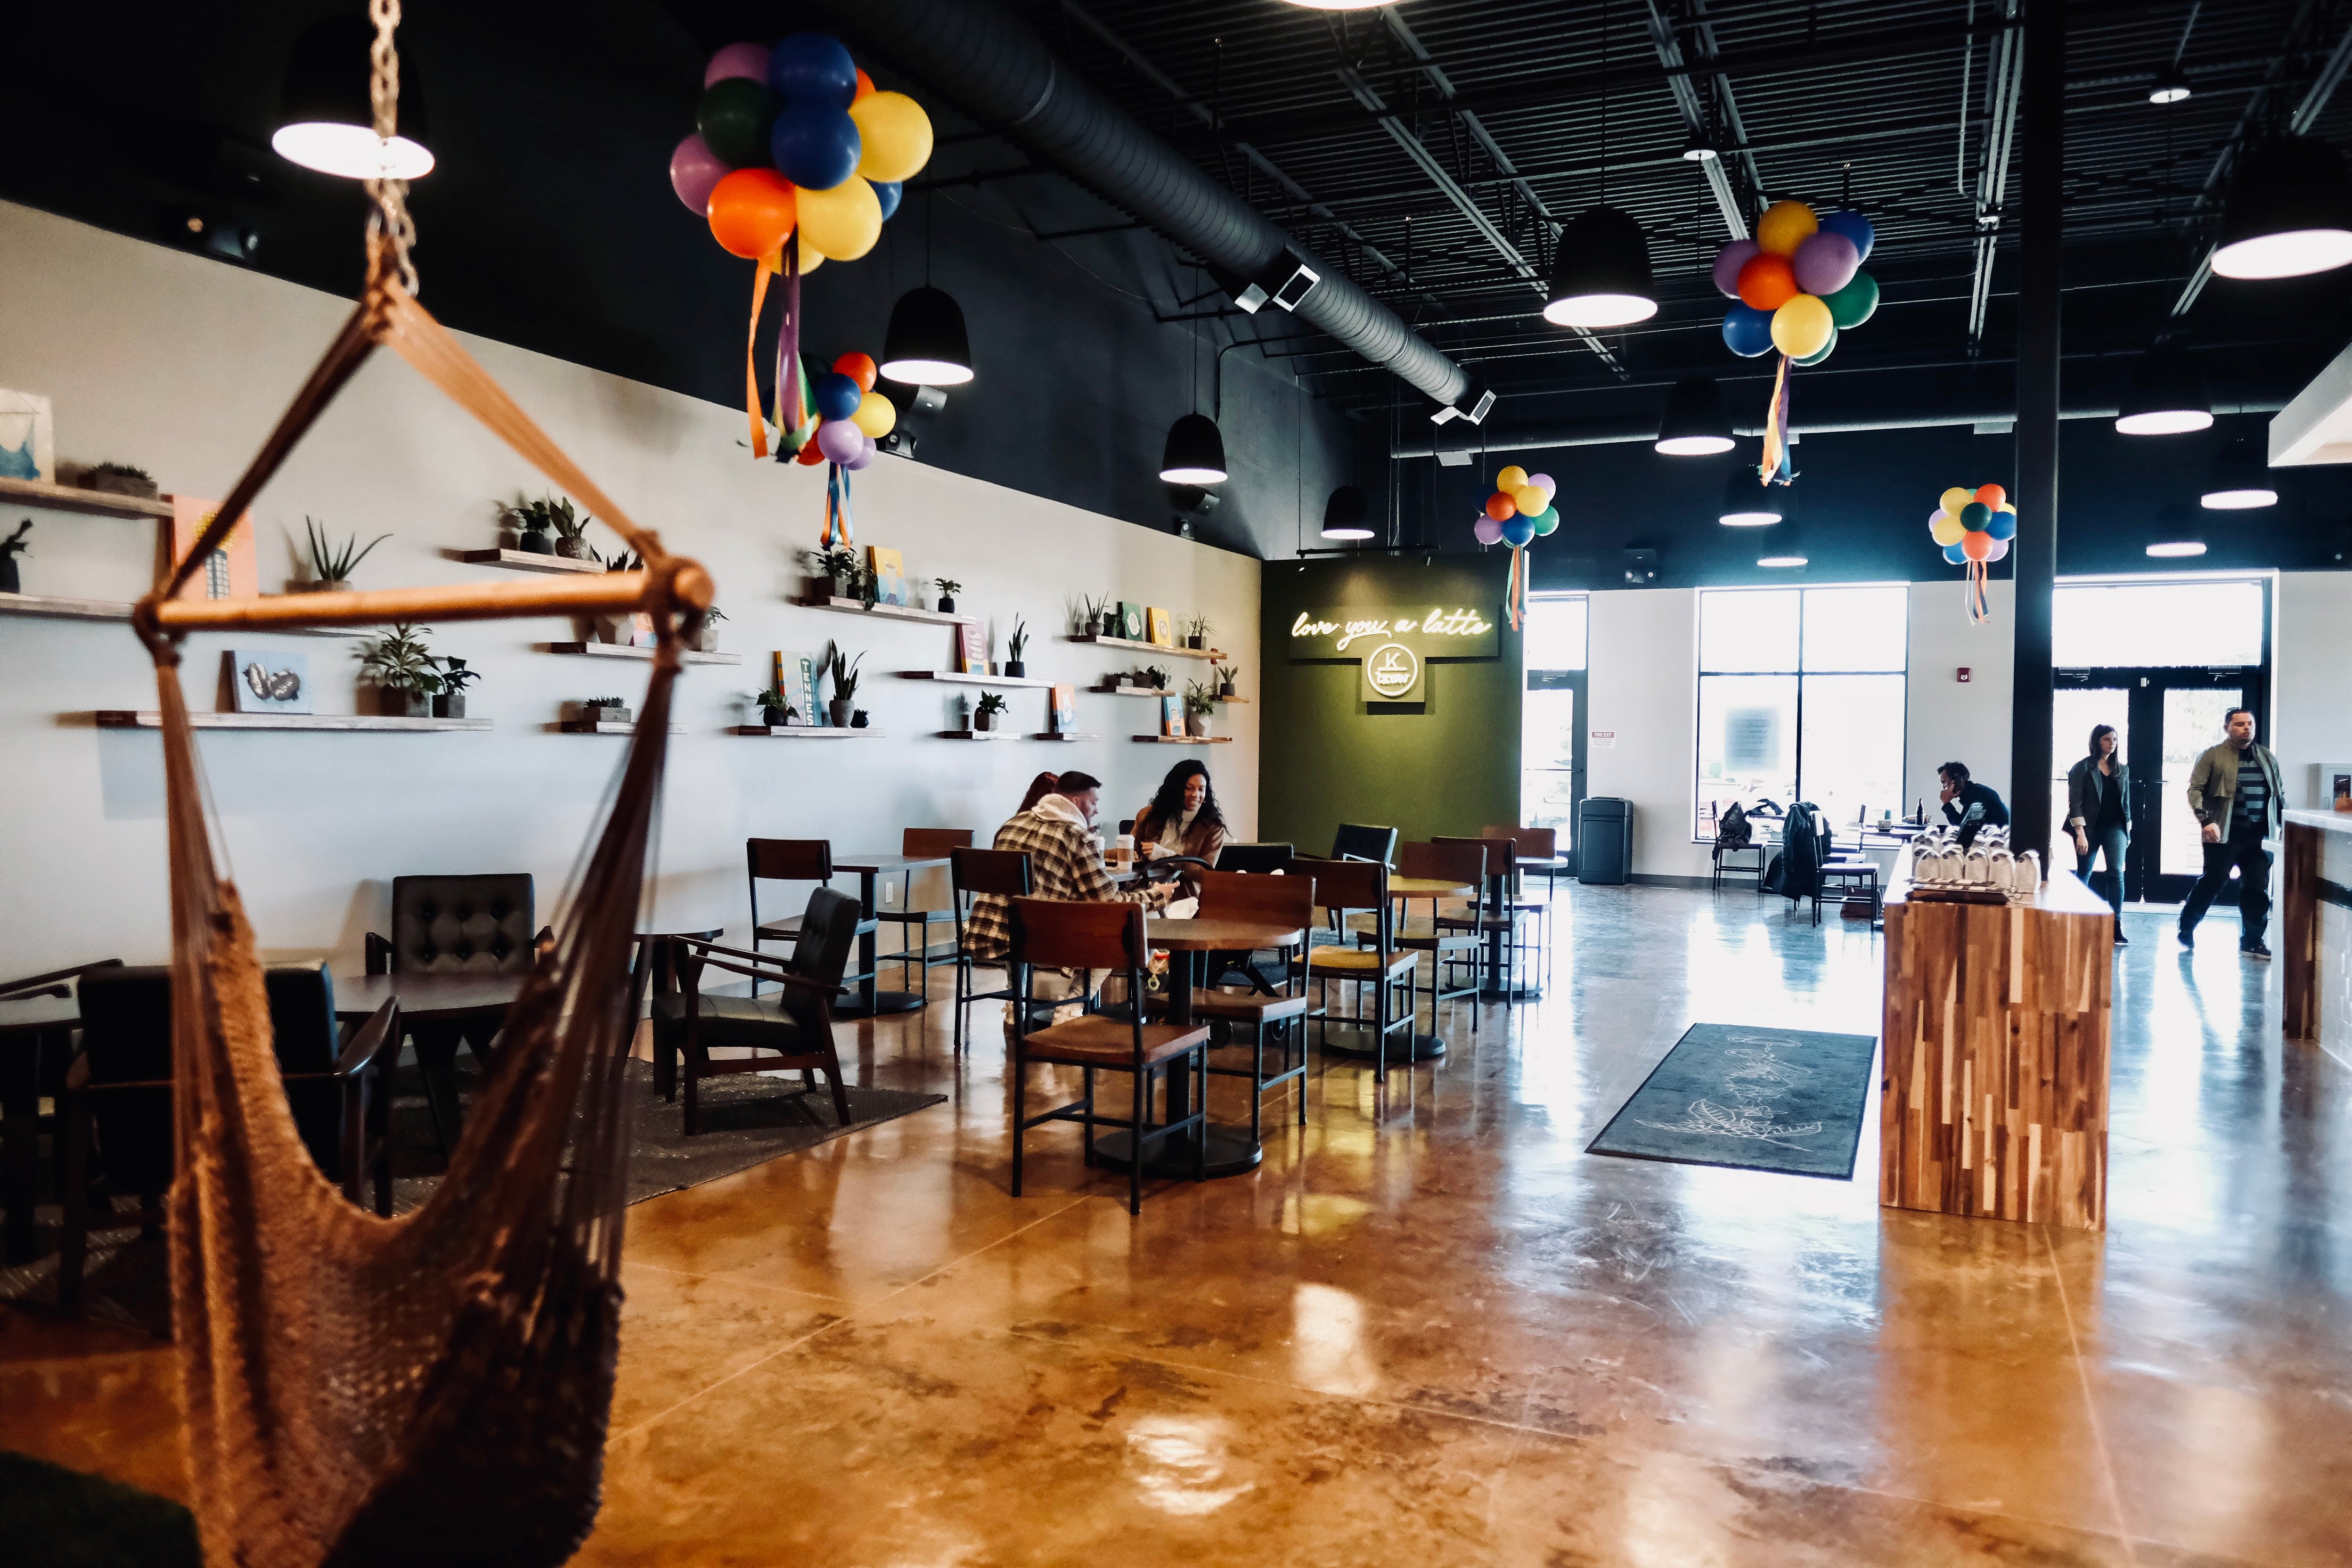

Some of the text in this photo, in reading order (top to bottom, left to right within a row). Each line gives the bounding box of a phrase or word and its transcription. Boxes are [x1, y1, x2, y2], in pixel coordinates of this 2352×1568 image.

[1291, 608, 1492, 651] love you a latte
[1386, 652, 1400, 669] K
